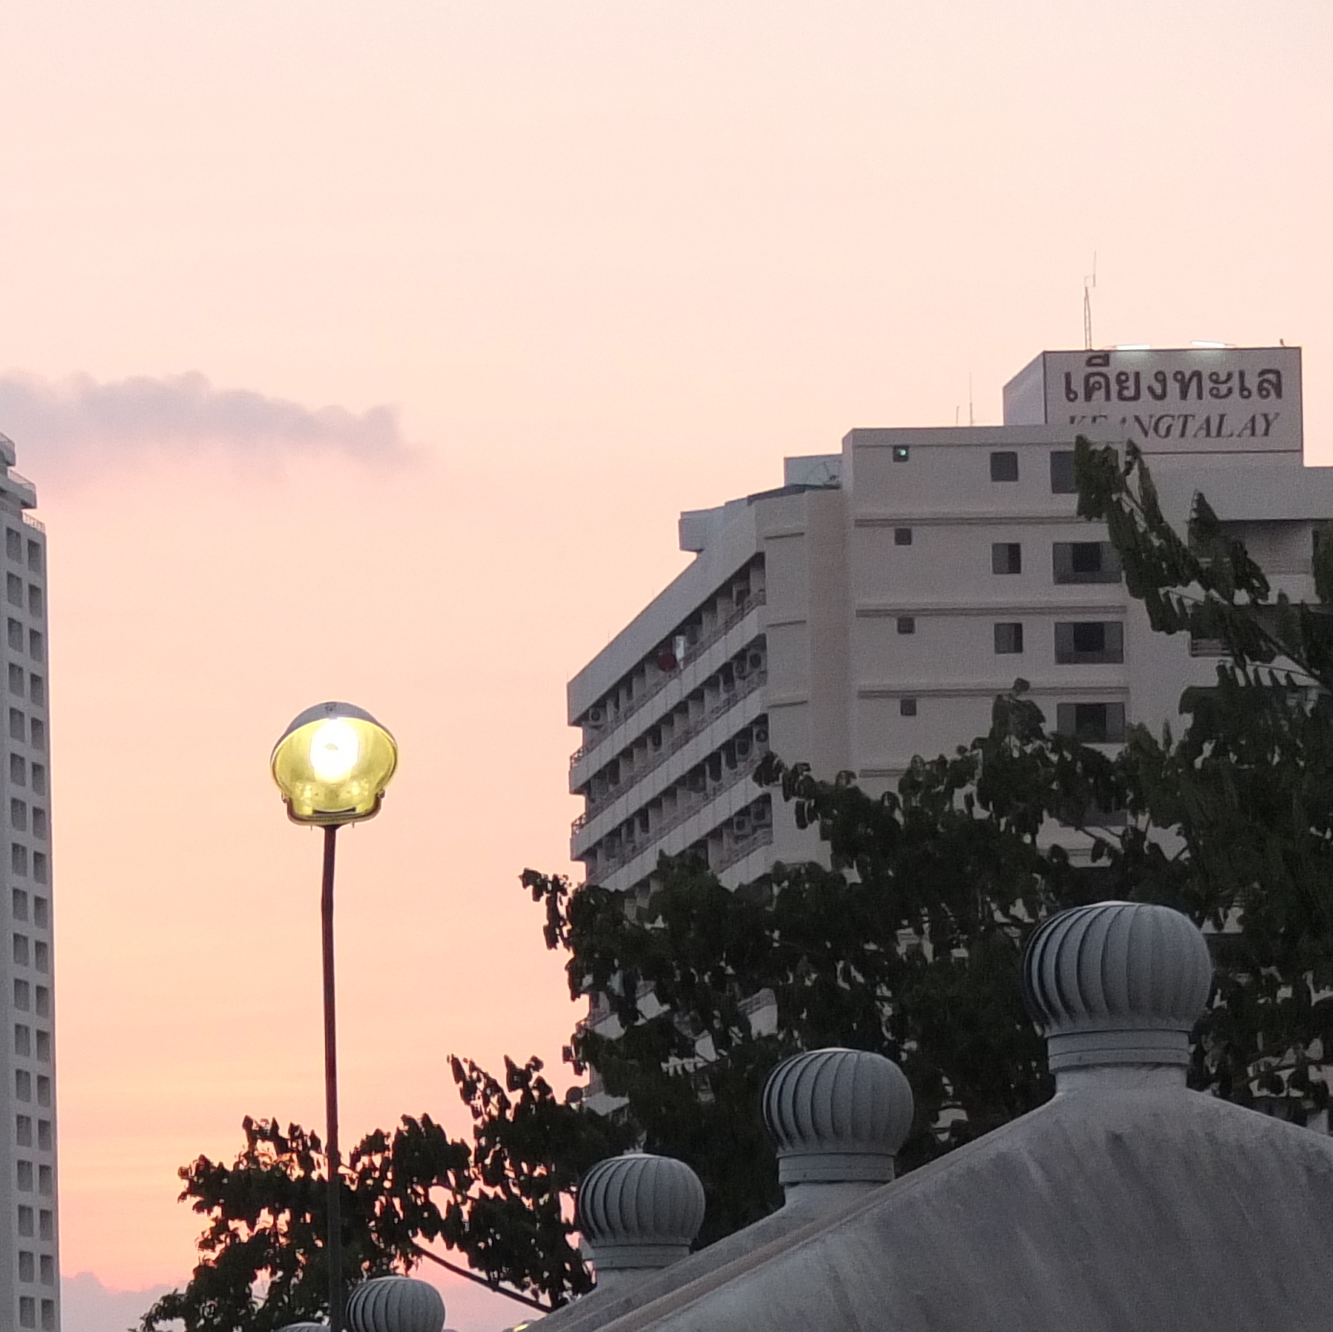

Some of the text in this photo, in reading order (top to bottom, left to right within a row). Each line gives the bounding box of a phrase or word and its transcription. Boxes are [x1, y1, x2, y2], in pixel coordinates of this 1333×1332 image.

[1064, 353, 1283, 402] เคียงทะเล
[1069, 413, 1280, 439] NGTALAY
